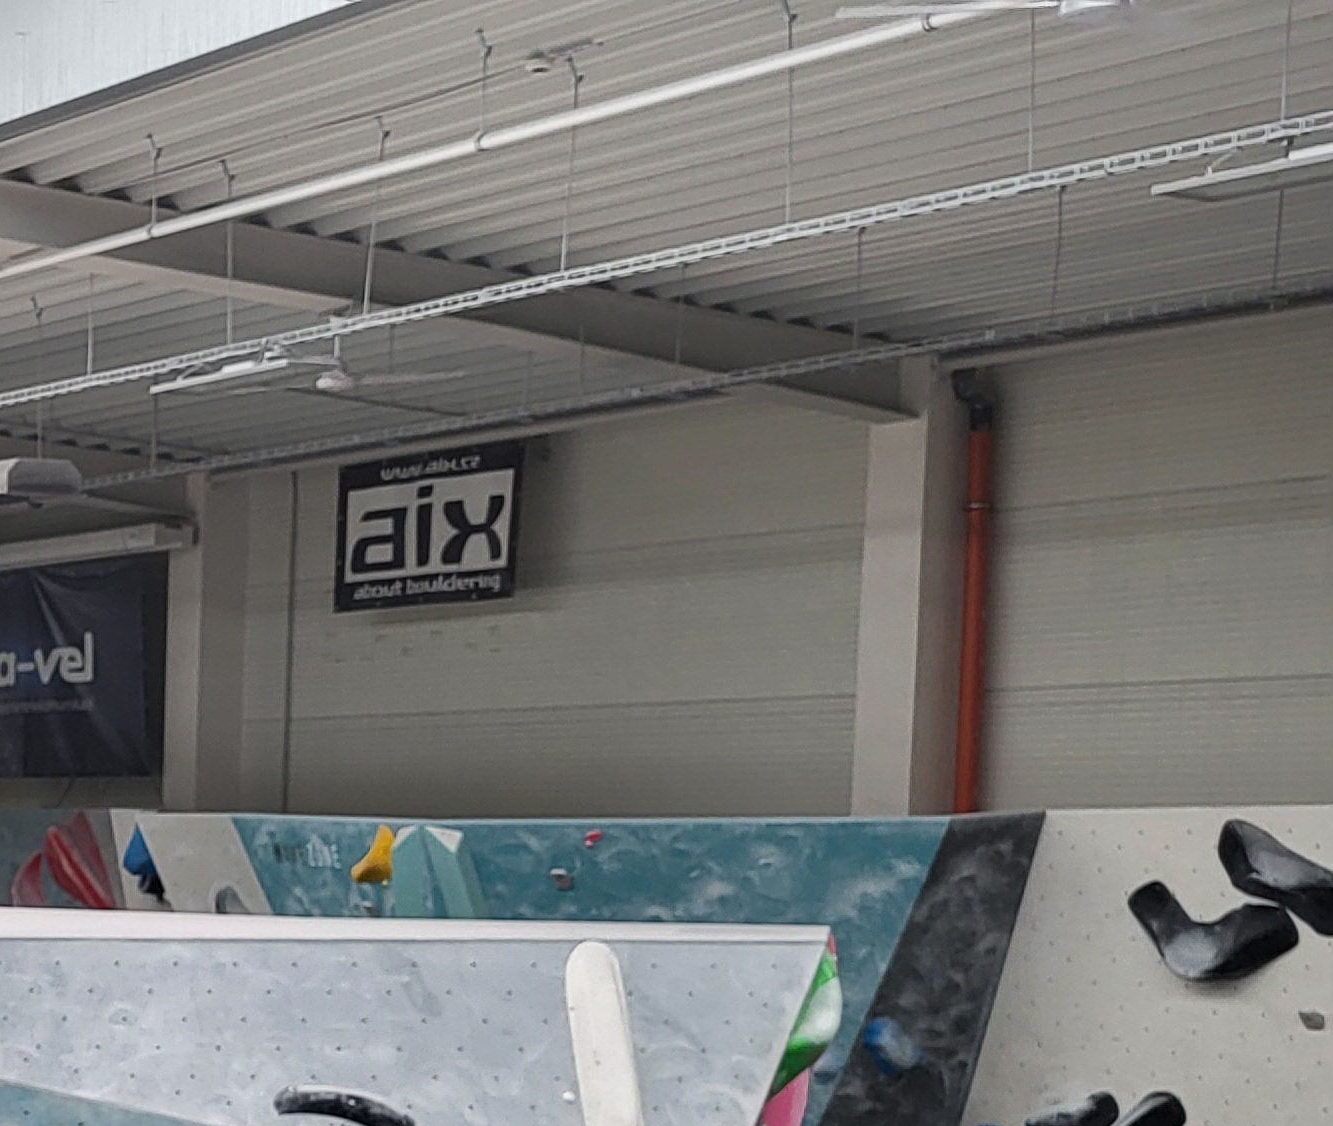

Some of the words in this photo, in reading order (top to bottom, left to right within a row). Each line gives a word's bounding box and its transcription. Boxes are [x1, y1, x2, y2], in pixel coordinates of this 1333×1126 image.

[351, 484, 504, 574] aix
[353, 580, 403, 600] about
[406, 573, 501, 594] bouldering
